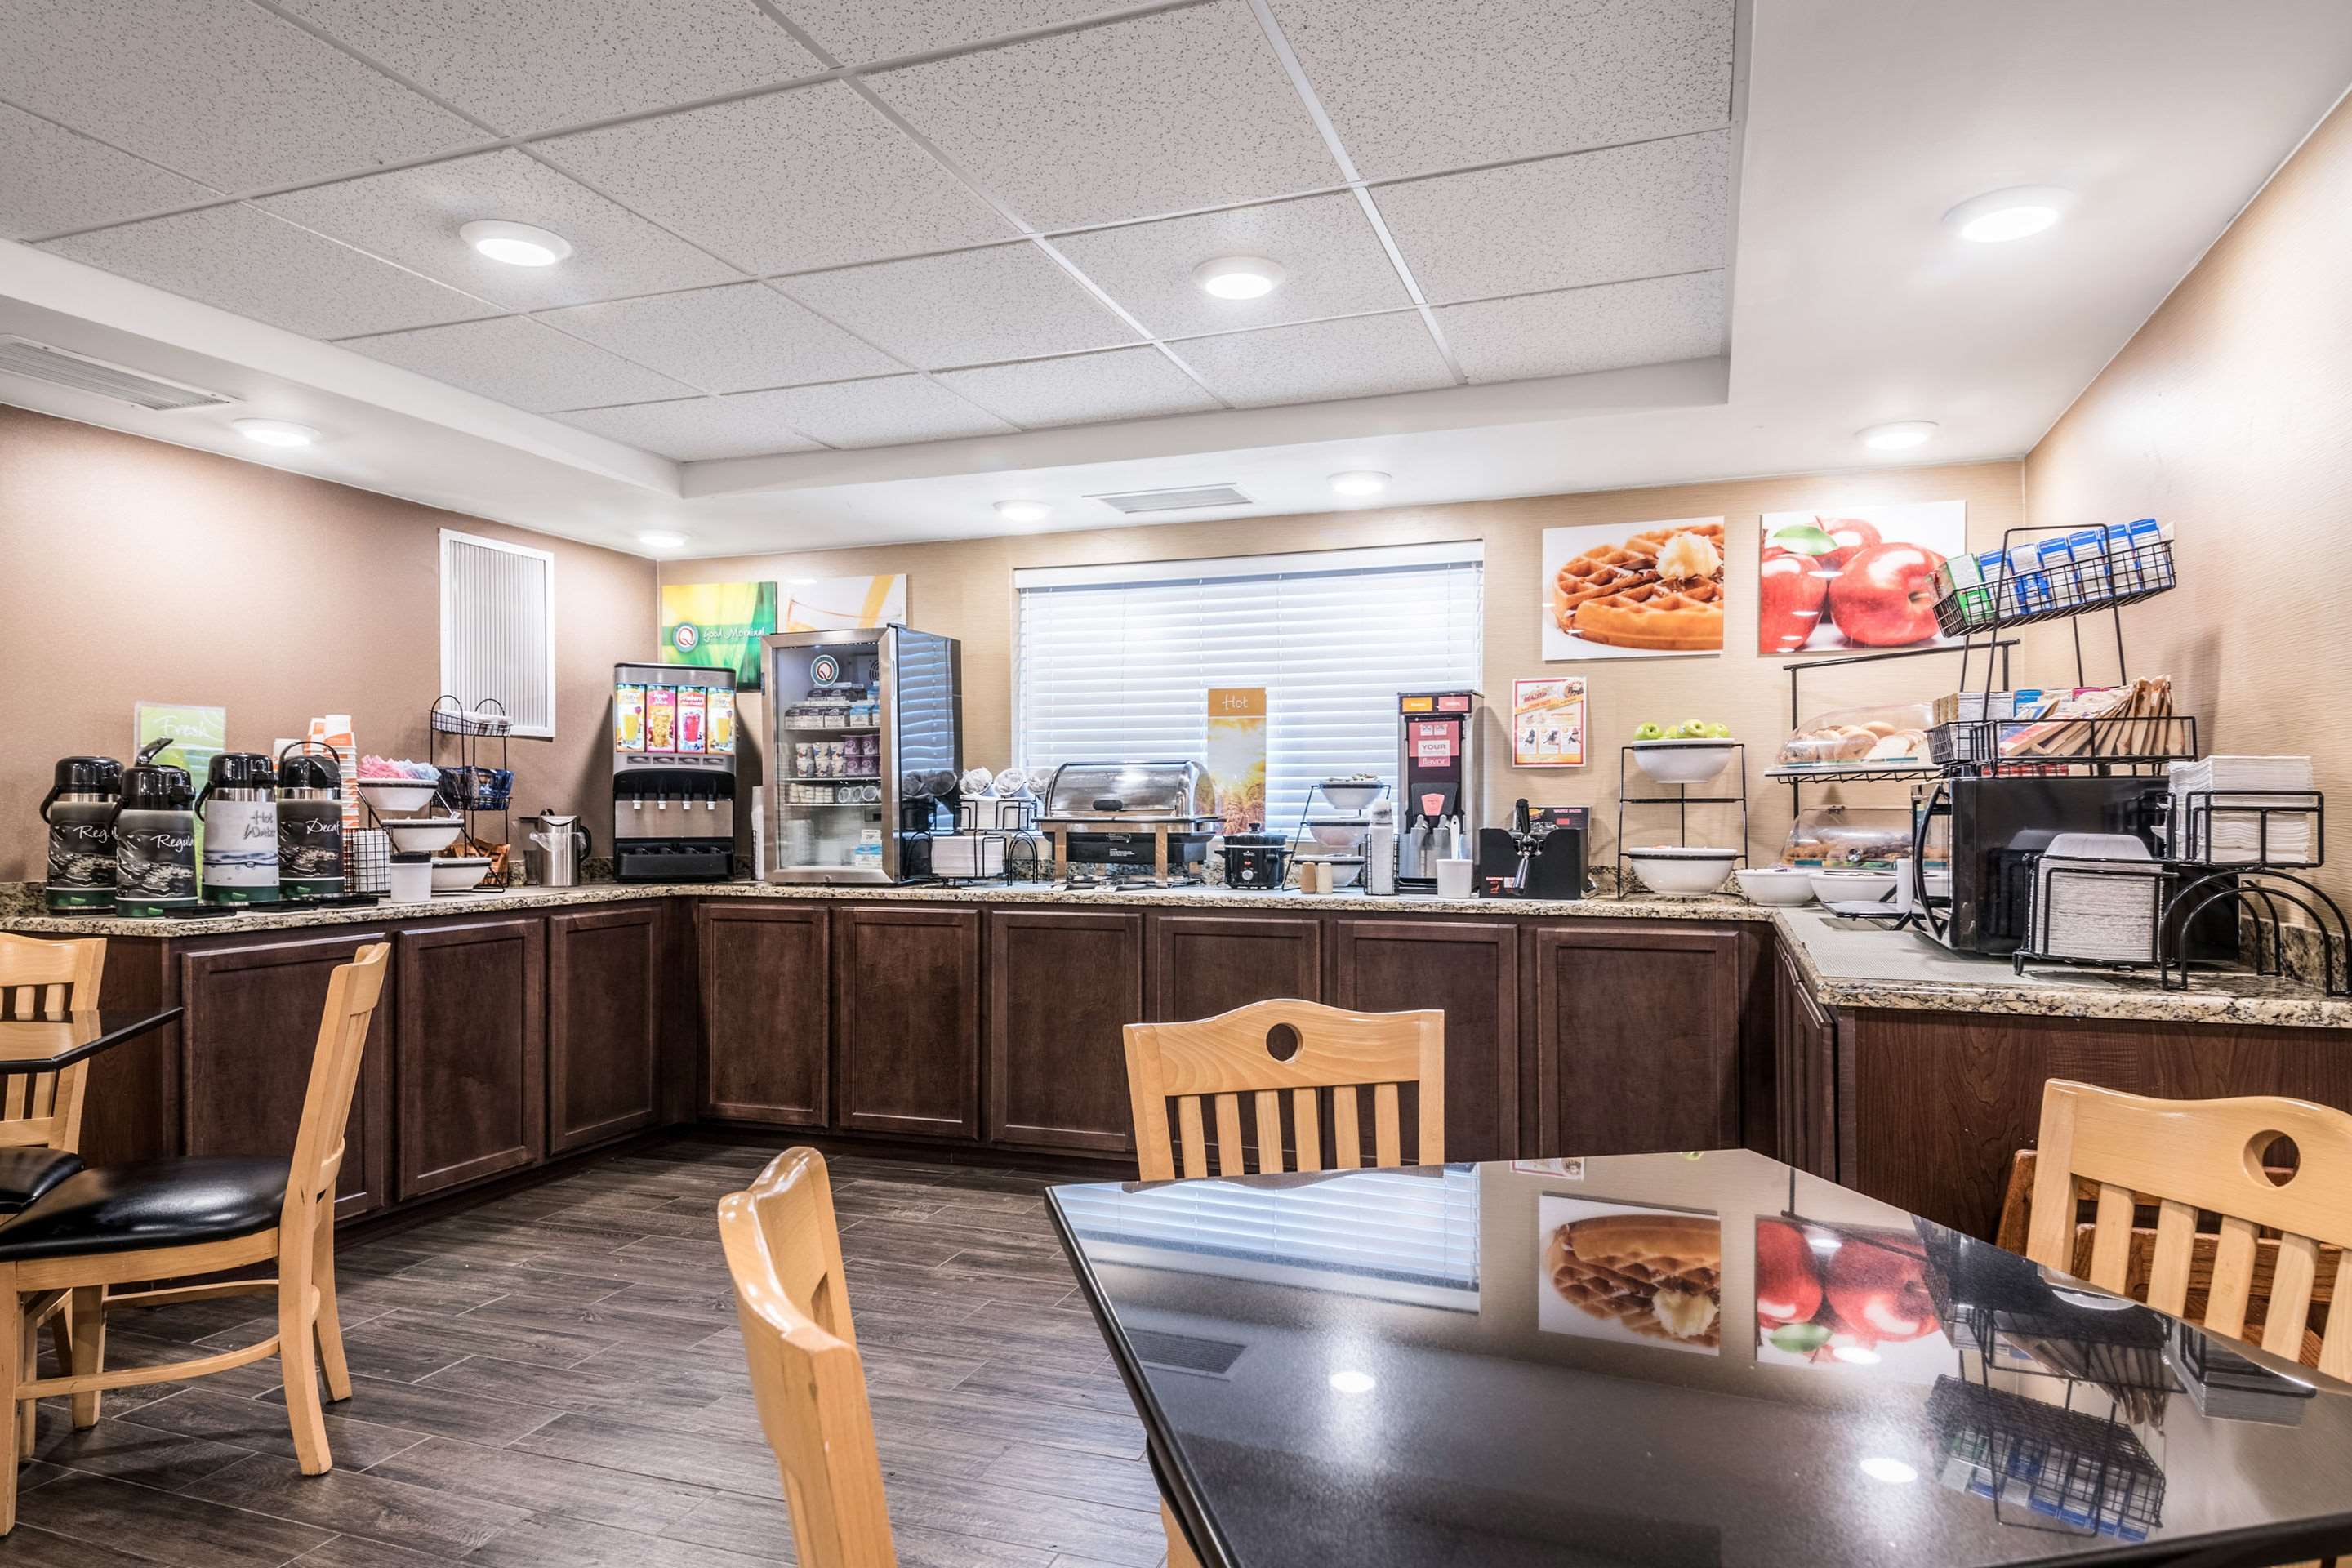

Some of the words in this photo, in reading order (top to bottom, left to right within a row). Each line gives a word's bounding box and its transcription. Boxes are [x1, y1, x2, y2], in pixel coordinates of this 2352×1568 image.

[703, 626, 723, 644] Good
[1222, 693, 1248, 710] Hot
[153, 715, 209, 737] Fresh
[250, 810, 273, 824] Hot
[243, 824, 276, 840] Water
[305, 817, 340, 835] Decaf
